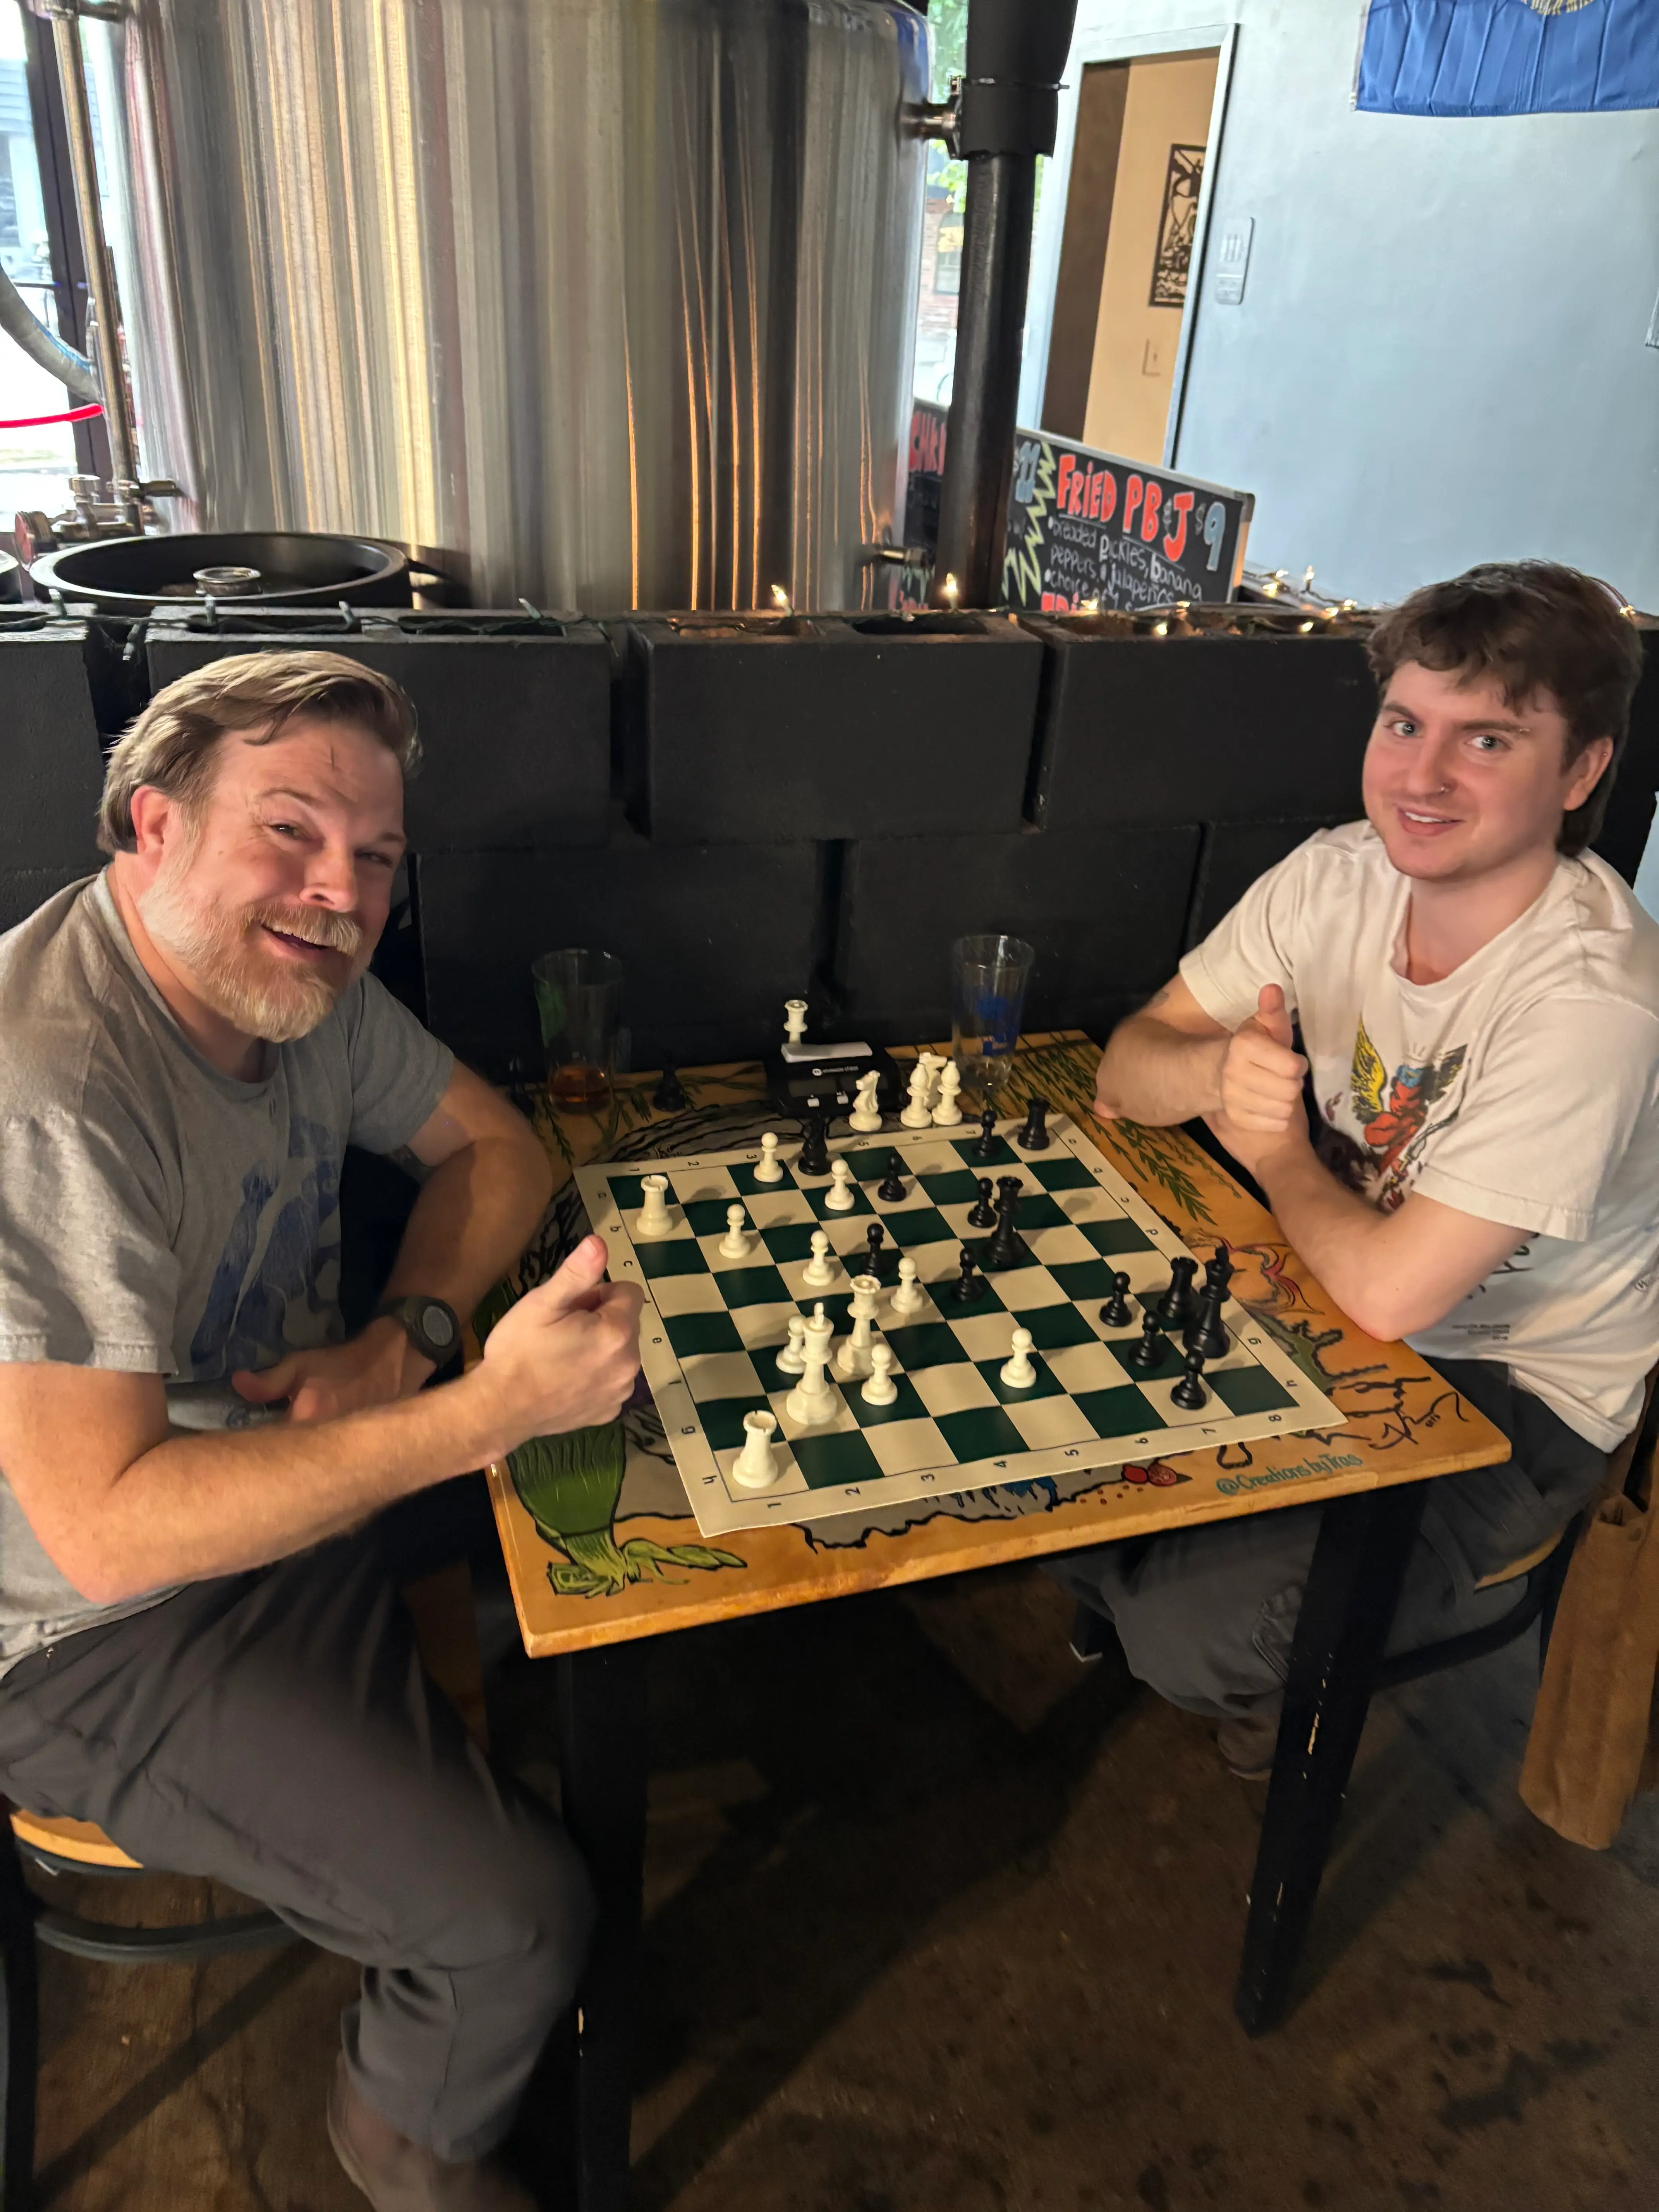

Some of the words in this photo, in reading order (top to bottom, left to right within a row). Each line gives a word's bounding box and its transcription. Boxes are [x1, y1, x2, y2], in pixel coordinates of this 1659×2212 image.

[1151, 553, 1202, 601] banana
[845, 1487, 861, 1496] 2
[921, 1474, 935, 1482] 3
[1268, 1414, 1282, 1422] 8
